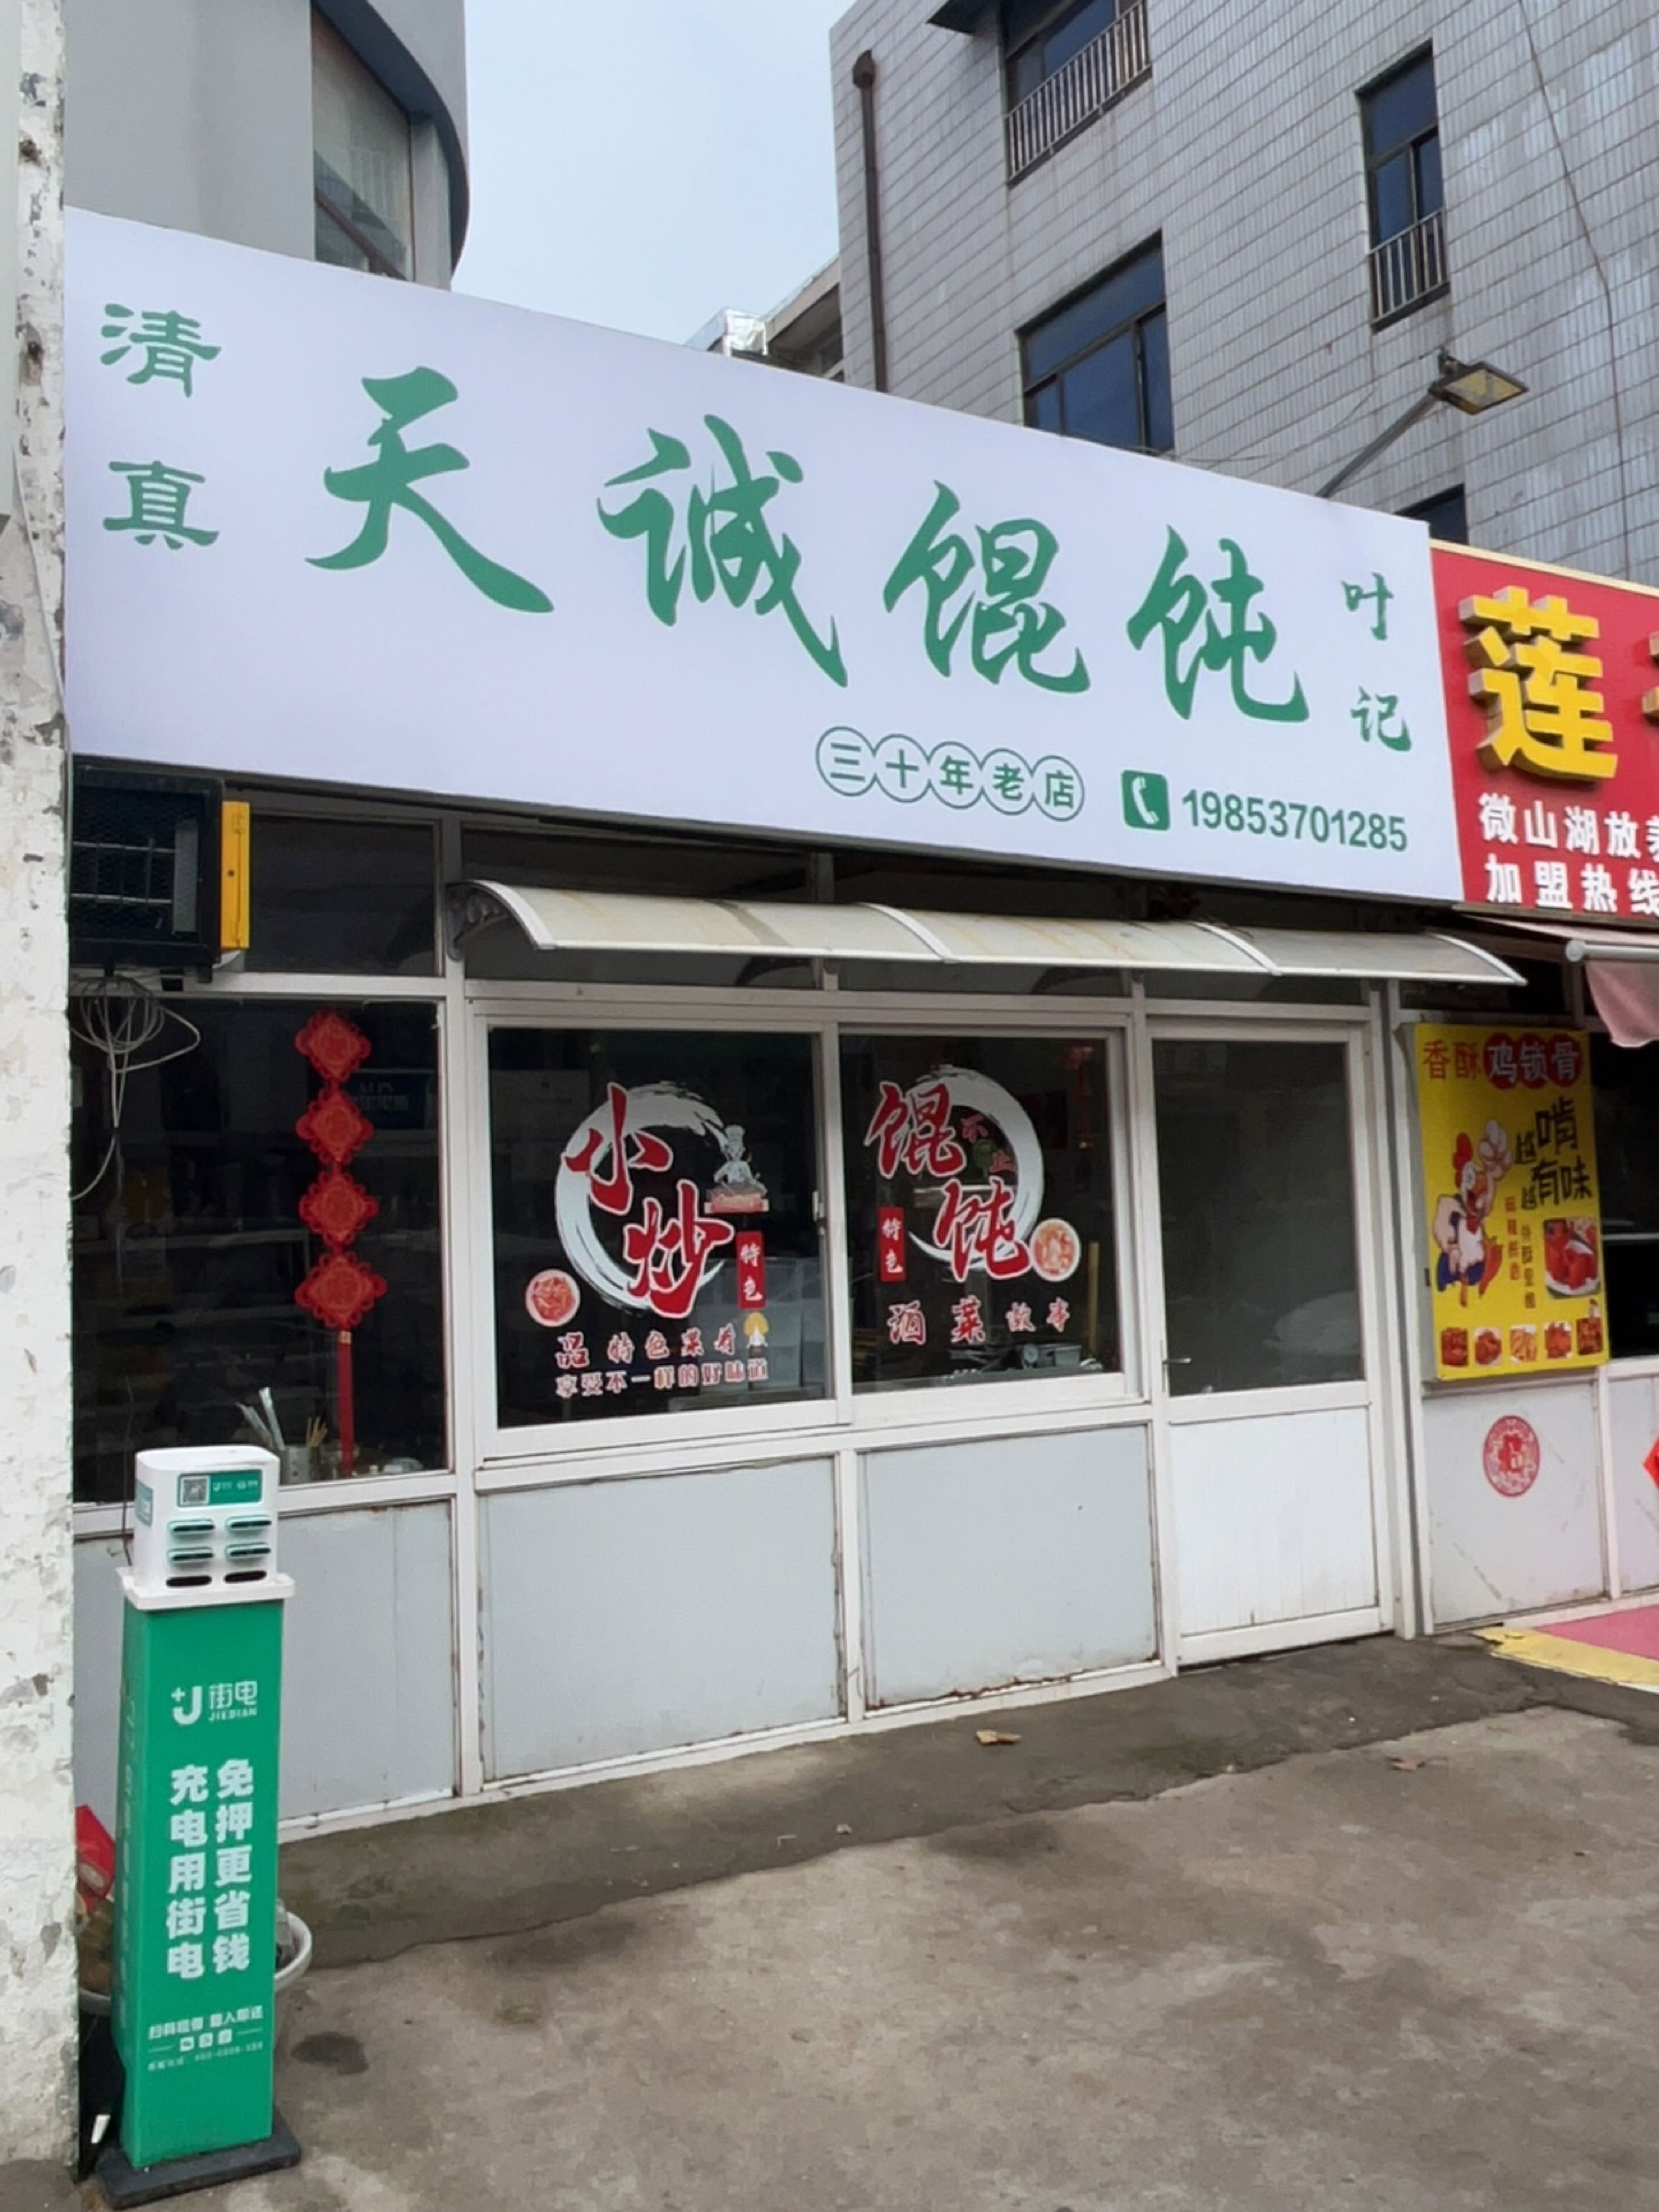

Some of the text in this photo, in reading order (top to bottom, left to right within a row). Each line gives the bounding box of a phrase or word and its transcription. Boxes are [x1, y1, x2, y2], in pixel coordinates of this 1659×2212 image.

[99, 303, 221, 550] 清真
[304, 367, 1310, 722] 天诚馄饨
[1341, 572, 1412, 752] 叶记
[1460, 585, 1659, 780] 莲
[830, 742, 1074, 808] 三十年老店
[1182, 789, 1407, 853] 19853701285
[563, 1082, 735, 1319] 小炒
[740, 1242, 763, 1301] 特色
[864, 1082, 1034, 1281] 馄饨
[208, 1680, 257, 1710] 街电
[208, 1707, 257, 1722] JIEDIAN
[166, 1765, 209, 1979] 充电用街电
[212, 1759, 254, 1974] 免押更省钱
